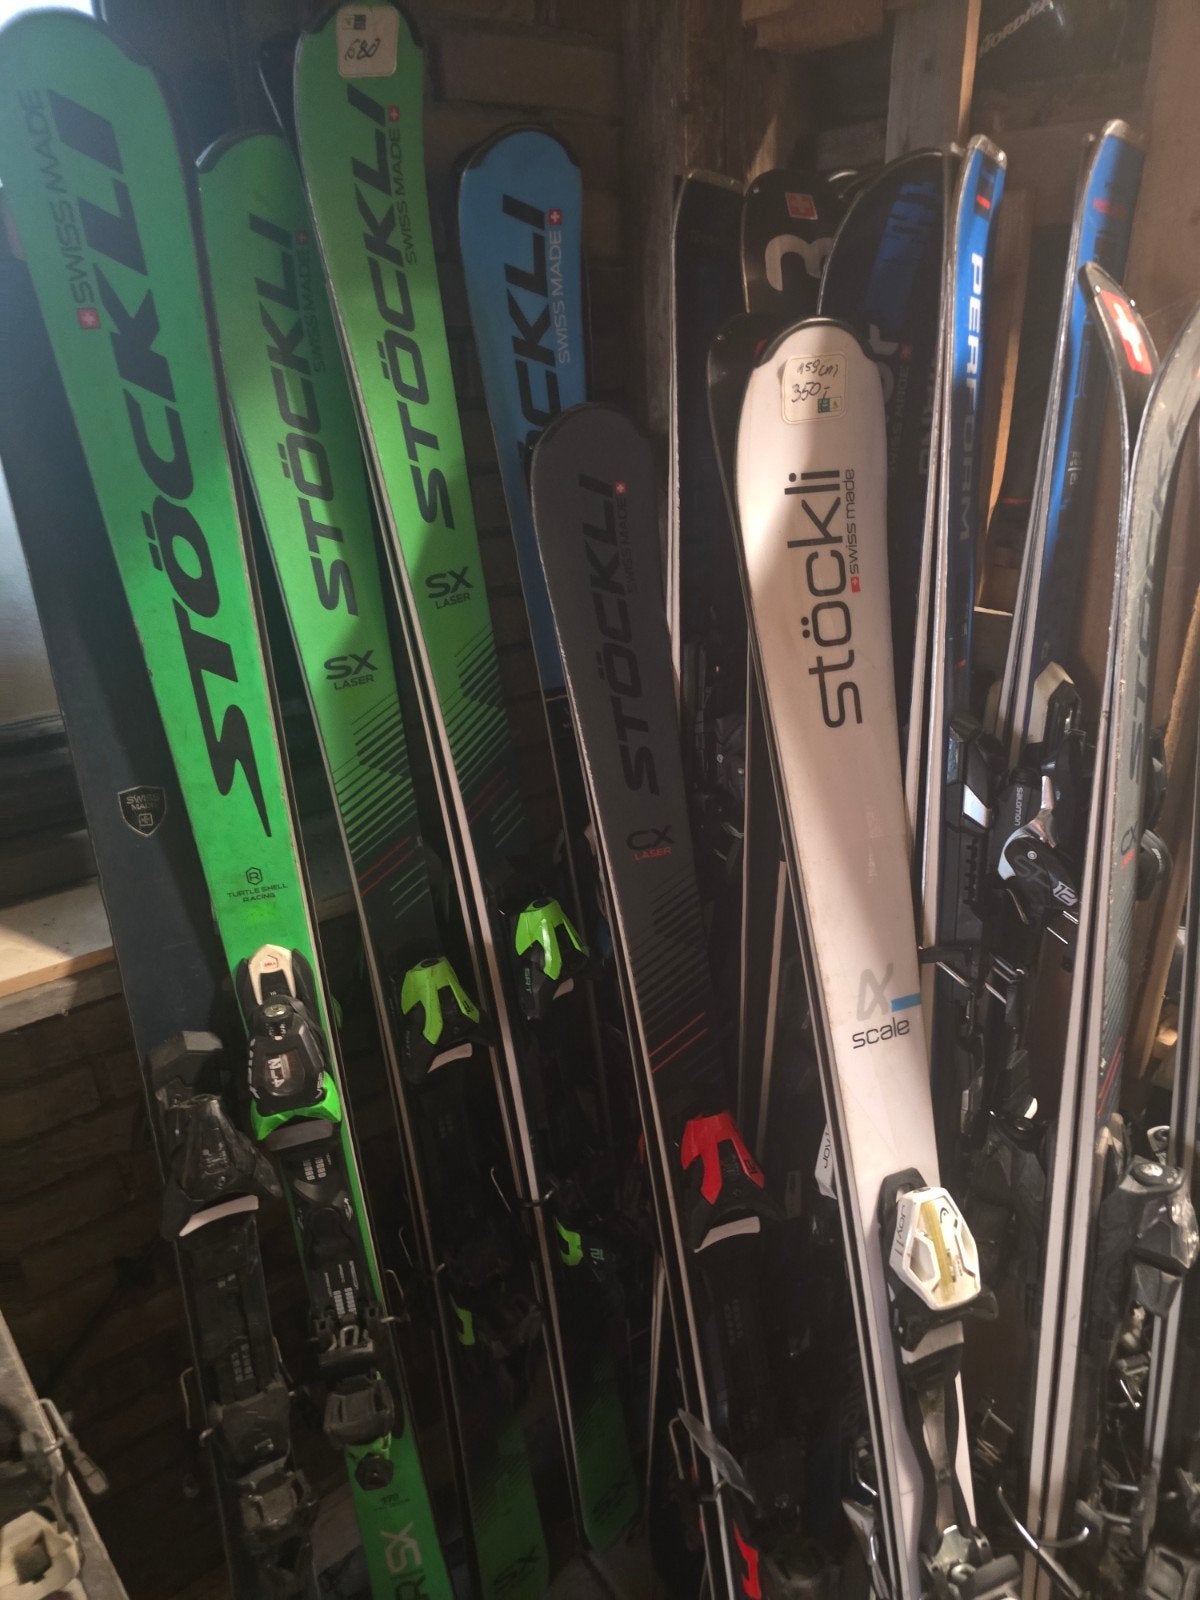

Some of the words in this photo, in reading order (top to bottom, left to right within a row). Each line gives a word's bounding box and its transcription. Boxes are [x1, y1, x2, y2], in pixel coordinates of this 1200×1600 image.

[17, 87, 69, 196] MADE
[388, 127, 406, 197] MADE
[49, 197, 96, 304] SWISS
[396, 200, 417, 266] SWISS
[549, 230, 565, 297] MADE
[346, 82, 456, 530] STÖCKLI
[551, 299, 571, 364] SWISS
[248, 212, 360, 617] STÖCKLI
[46, 87, 271, 838] STÖCKLI
[842, 468, 856, 519] made
[846, 522, 859, 575] swiss
[424, 566, 475, 600] SX
[434, 592, 471, 610] LASER
[578, 473, 661, 797] STÖCKLI
[323, 649, 378, 681] SX
[334, 674, 375, 692] LASER
[626, 823, 675, 852] CX
[633, 846, 673, 863] LASER
[226, 887, 260, 898] TURTLE
[243, 892, 276, 903] RACING
[1052, 880, 1080, 907] 12
[853, 1017, 911, 1050] scale
